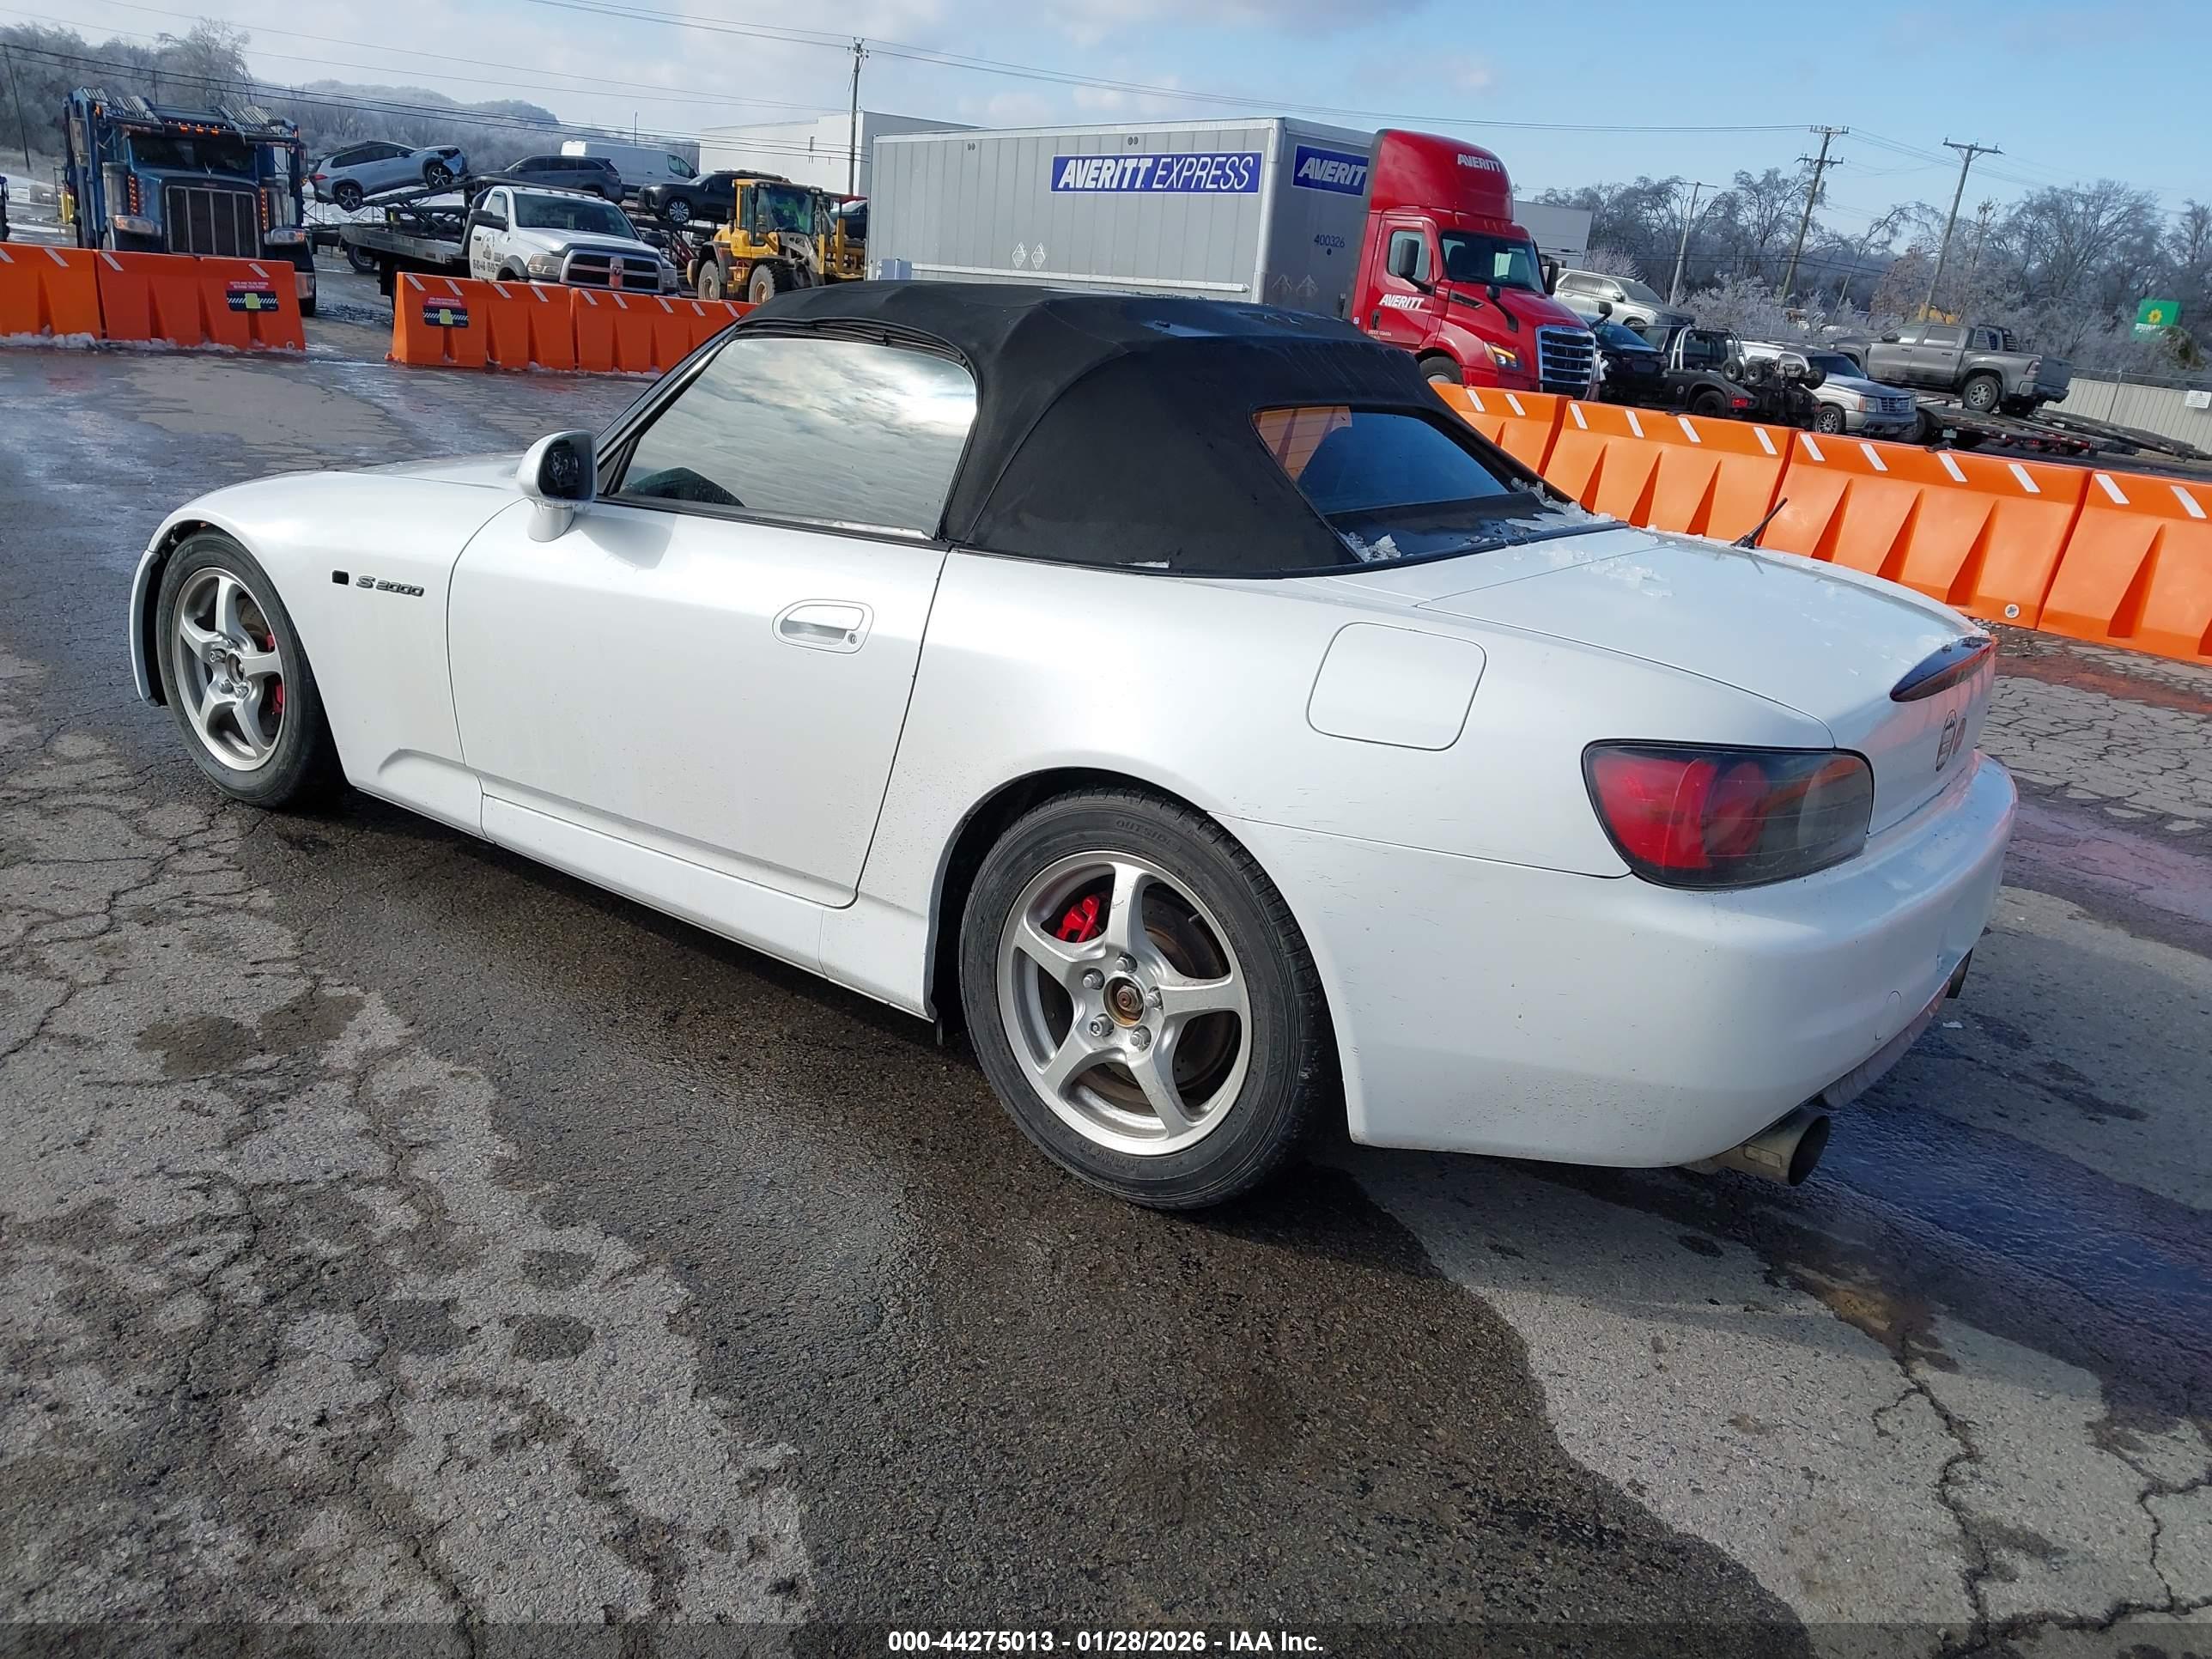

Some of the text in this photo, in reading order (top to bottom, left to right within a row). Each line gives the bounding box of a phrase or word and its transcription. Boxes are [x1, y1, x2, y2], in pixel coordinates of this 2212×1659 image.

[1057, 155, 1255, 190] AVERITT EXPRESS
[1297, 157, 1368, 186] AVERIT
[1457, 154, 1501, 173] AVERITT
[1314, 234, 1346, 248] 400326
[1377, 294, 1425, 310] AVERITT
